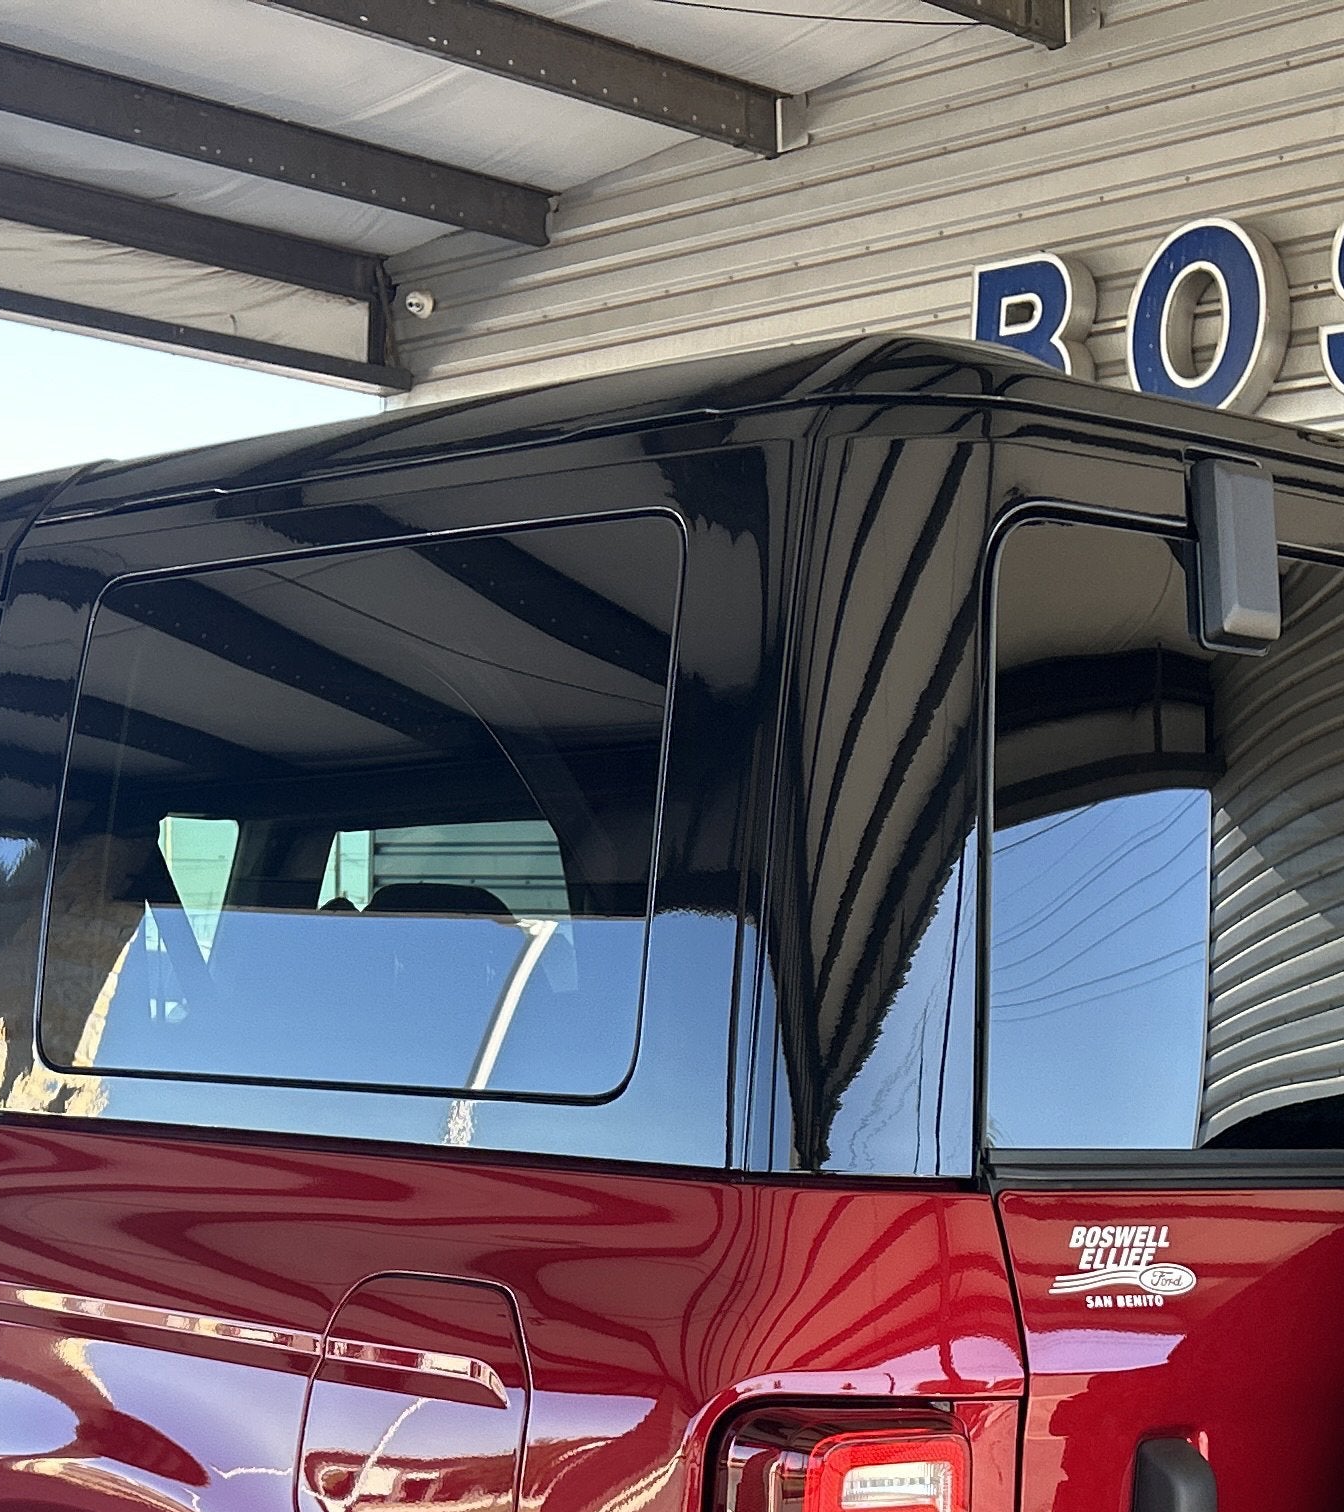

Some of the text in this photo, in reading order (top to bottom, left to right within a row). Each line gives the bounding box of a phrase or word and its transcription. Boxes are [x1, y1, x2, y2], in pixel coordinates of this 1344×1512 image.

[1068, 1225, 1171, 1249] BOSWELL
[1085, 1294, 1164, 1309] SAN BENITO
